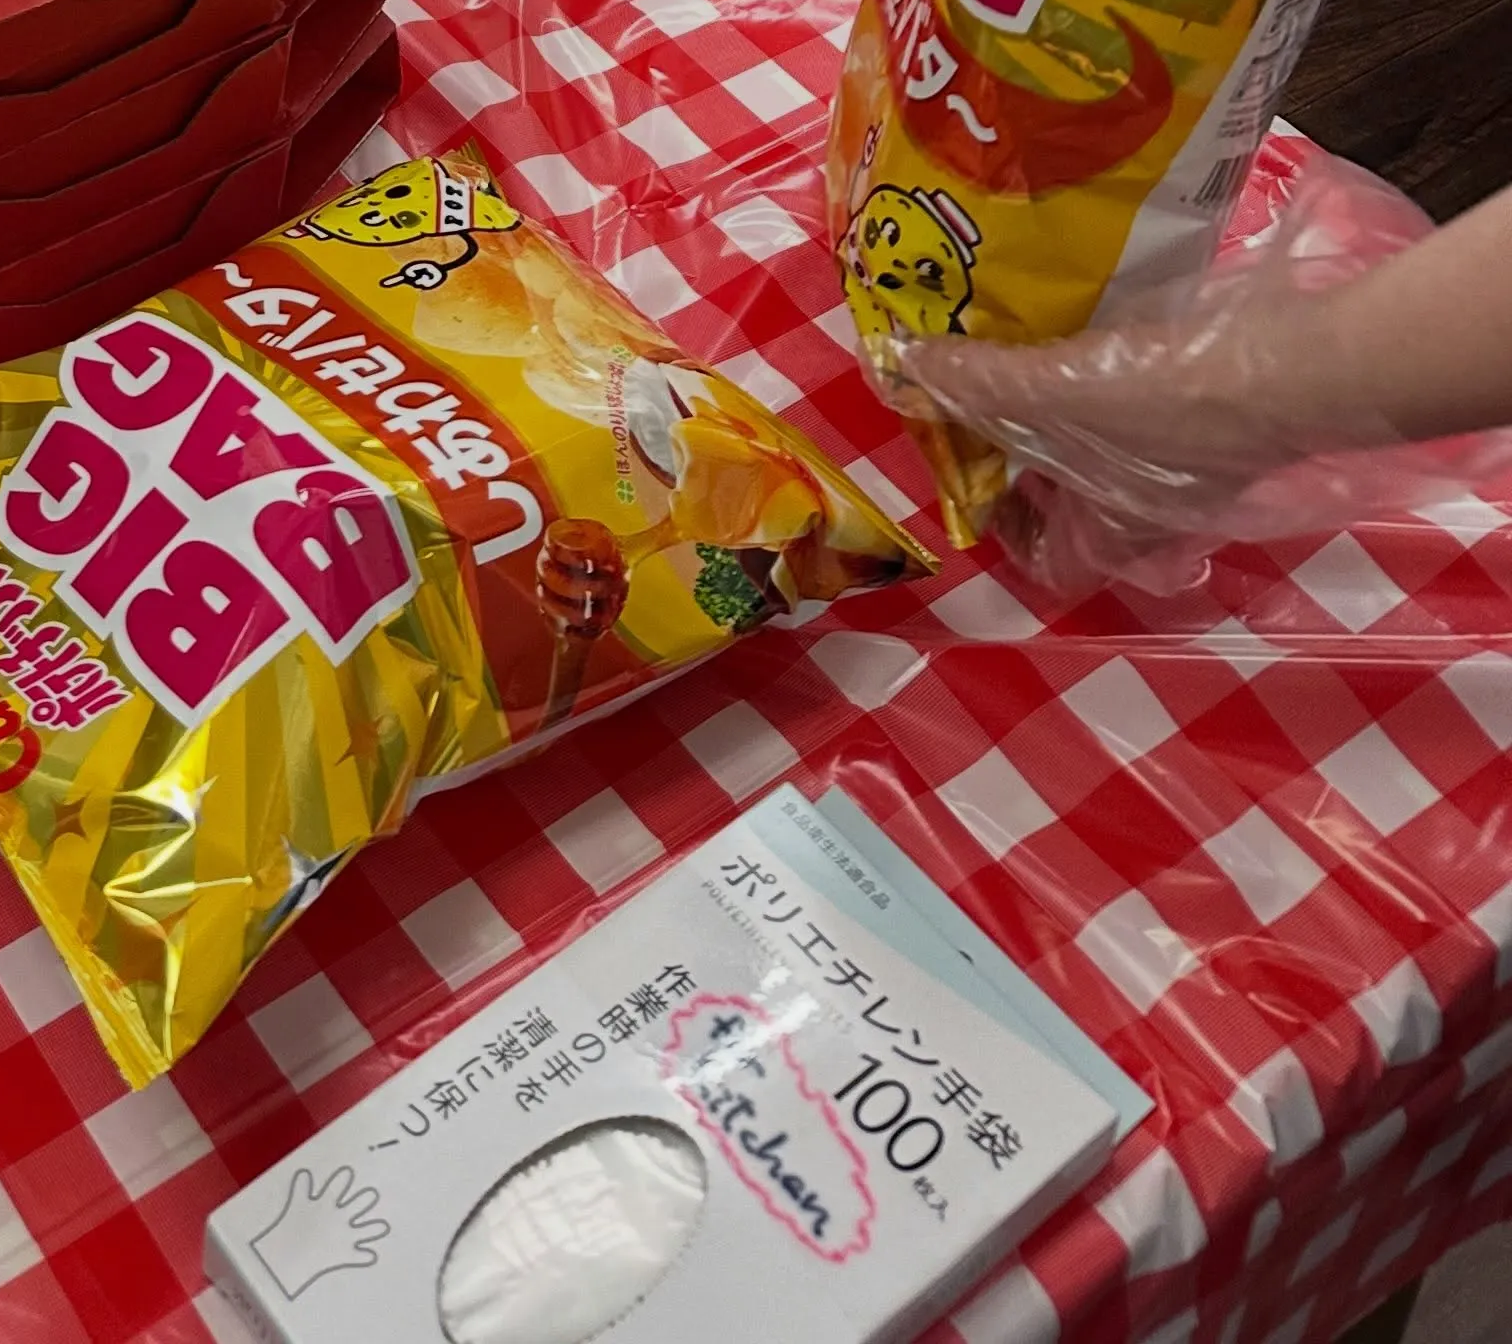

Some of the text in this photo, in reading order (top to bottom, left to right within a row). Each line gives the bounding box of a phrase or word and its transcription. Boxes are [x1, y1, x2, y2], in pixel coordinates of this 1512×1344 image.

[3, 416, 292, 711] BIG
[70, 319, 412, 646] BAG
[514, 964, 698, 1113] 作業時の手を
[719, 854, 1024, 1172] ポリエチレン手袋
